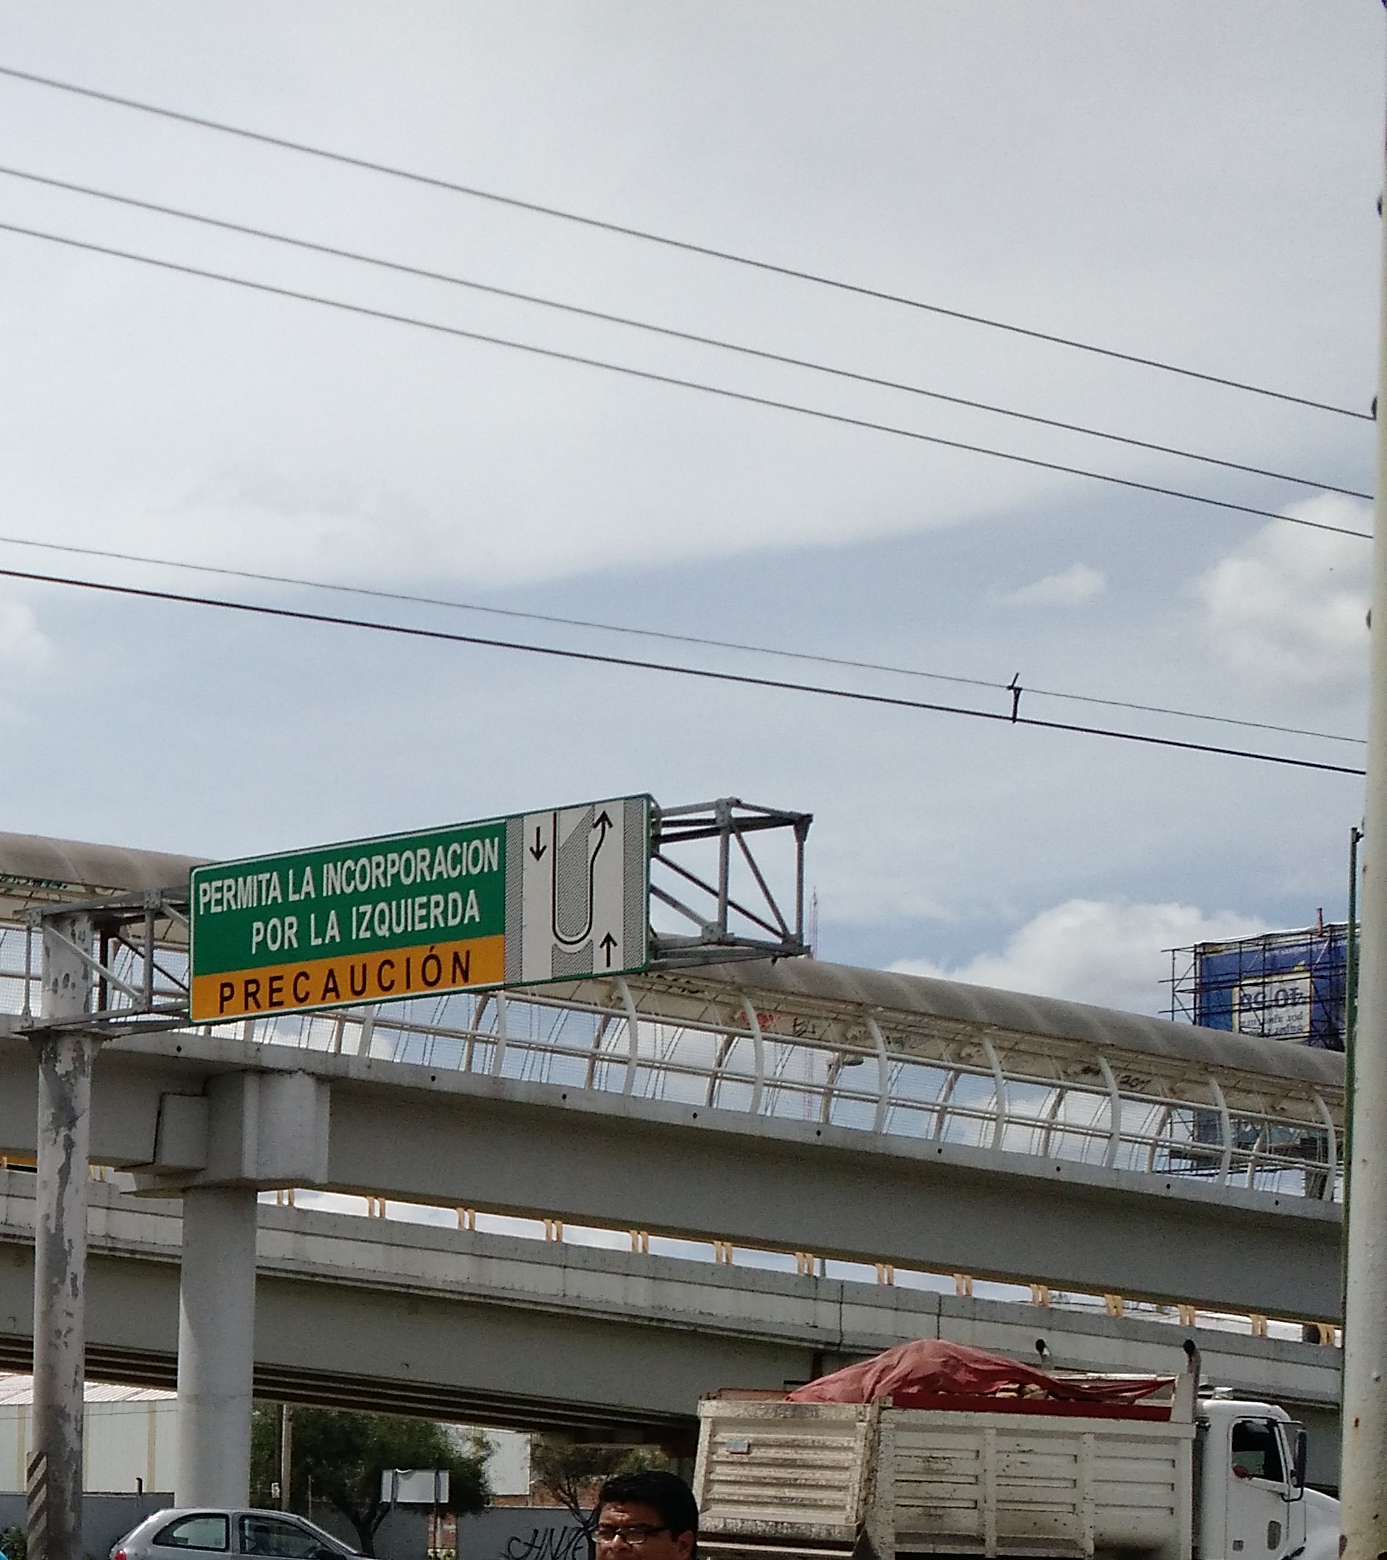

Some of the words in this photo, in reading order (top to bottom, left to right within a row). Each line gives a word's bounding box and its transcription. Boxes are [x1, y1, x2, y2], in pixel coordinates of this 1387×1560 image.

[199, 871, 282, 915] PERMITA
[289, 866, 315, 902] LA
[323, 837, 499, 897] INCORPORACION
[252, 916, 298, 954] POR
[310, 910, 341, 945] LA
[352, 889, 480, 939] IZQUIERDA
[219, 946, 470, 1013] PRECAUCIÓN
